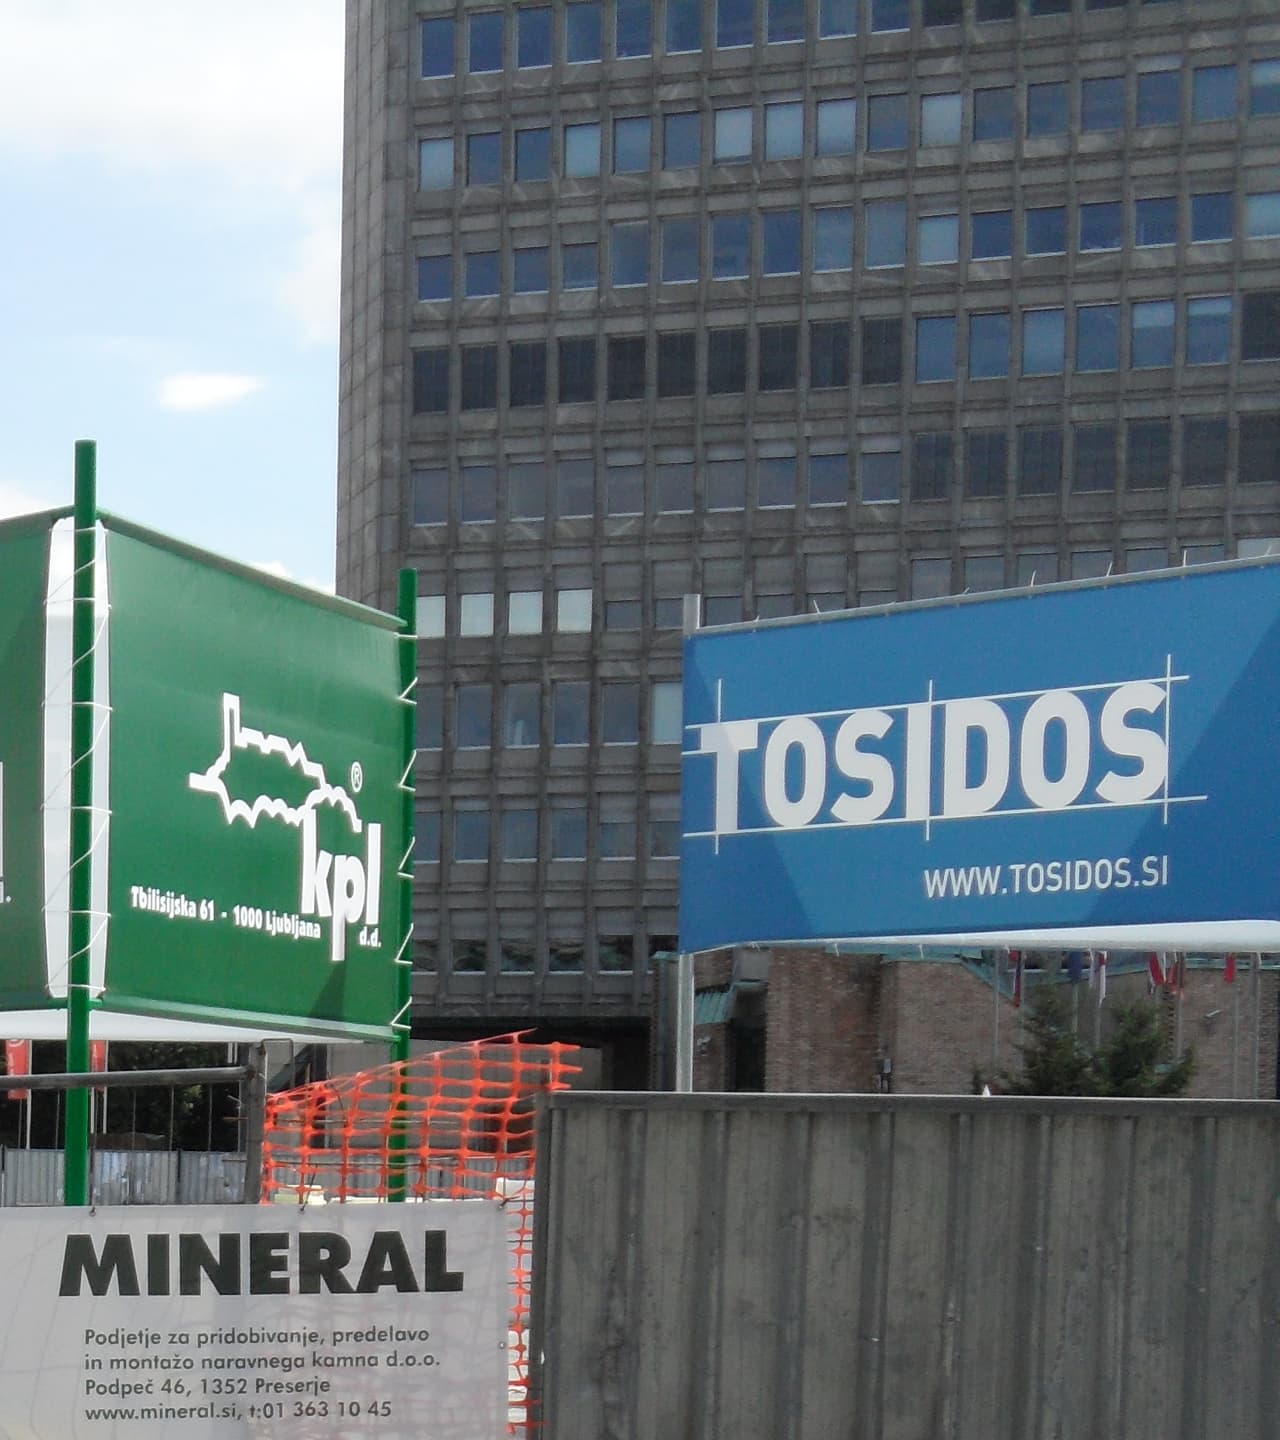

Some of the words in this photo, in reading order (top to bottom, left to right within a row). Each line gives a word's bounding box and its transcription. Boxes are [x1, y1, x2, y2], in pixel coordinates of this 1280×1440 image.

[700, 681, 1168, 833] TOSIDOS
[301, 809, 382, 962] kpl
[924, 855, 1169, 898] WWW.TOSIDOS.SI
[131, 885, 197, 919] Tbilisijska
[200, 898, 215, 921] 61
[233, 904, 263, 929] 1000
[266, 909, 321, 940] Ljubljana
[359, 926, 382, 947] d.d.
[57, 1230, 465, 1297] MINERAL
[85, 1328, 161, 1349] Podjetje
[168, 1334, 190, 1345] za
[197, 1326, 325, 1349] pridobivanje,
[333, 1325, 430, 1347] predelavo
[85, 1353, 103, 1370] in
[110, 1353, 194, 1370] montažo
[201, 1357, 305, 1373] naravnega
[312, 1350, 379, 1368] kamna
[386, 1350, 441, 1367] d.o.o.
[85, 1378, 154, 1399] Podpeč
[161, 1379, 192, 1397] 46,
[201, 1378, 248, 1395] 1352
[255, 1375, 331, 1397] Preserje
[85, 1402, 243, 1421] www.mineral.si,
[249, 1402, 284, 1419] t:01
[293, 1401, 329, 1417] 363
[338, 1401, 361, 1417] 10
[367, 1400, 392, 1417] 45
